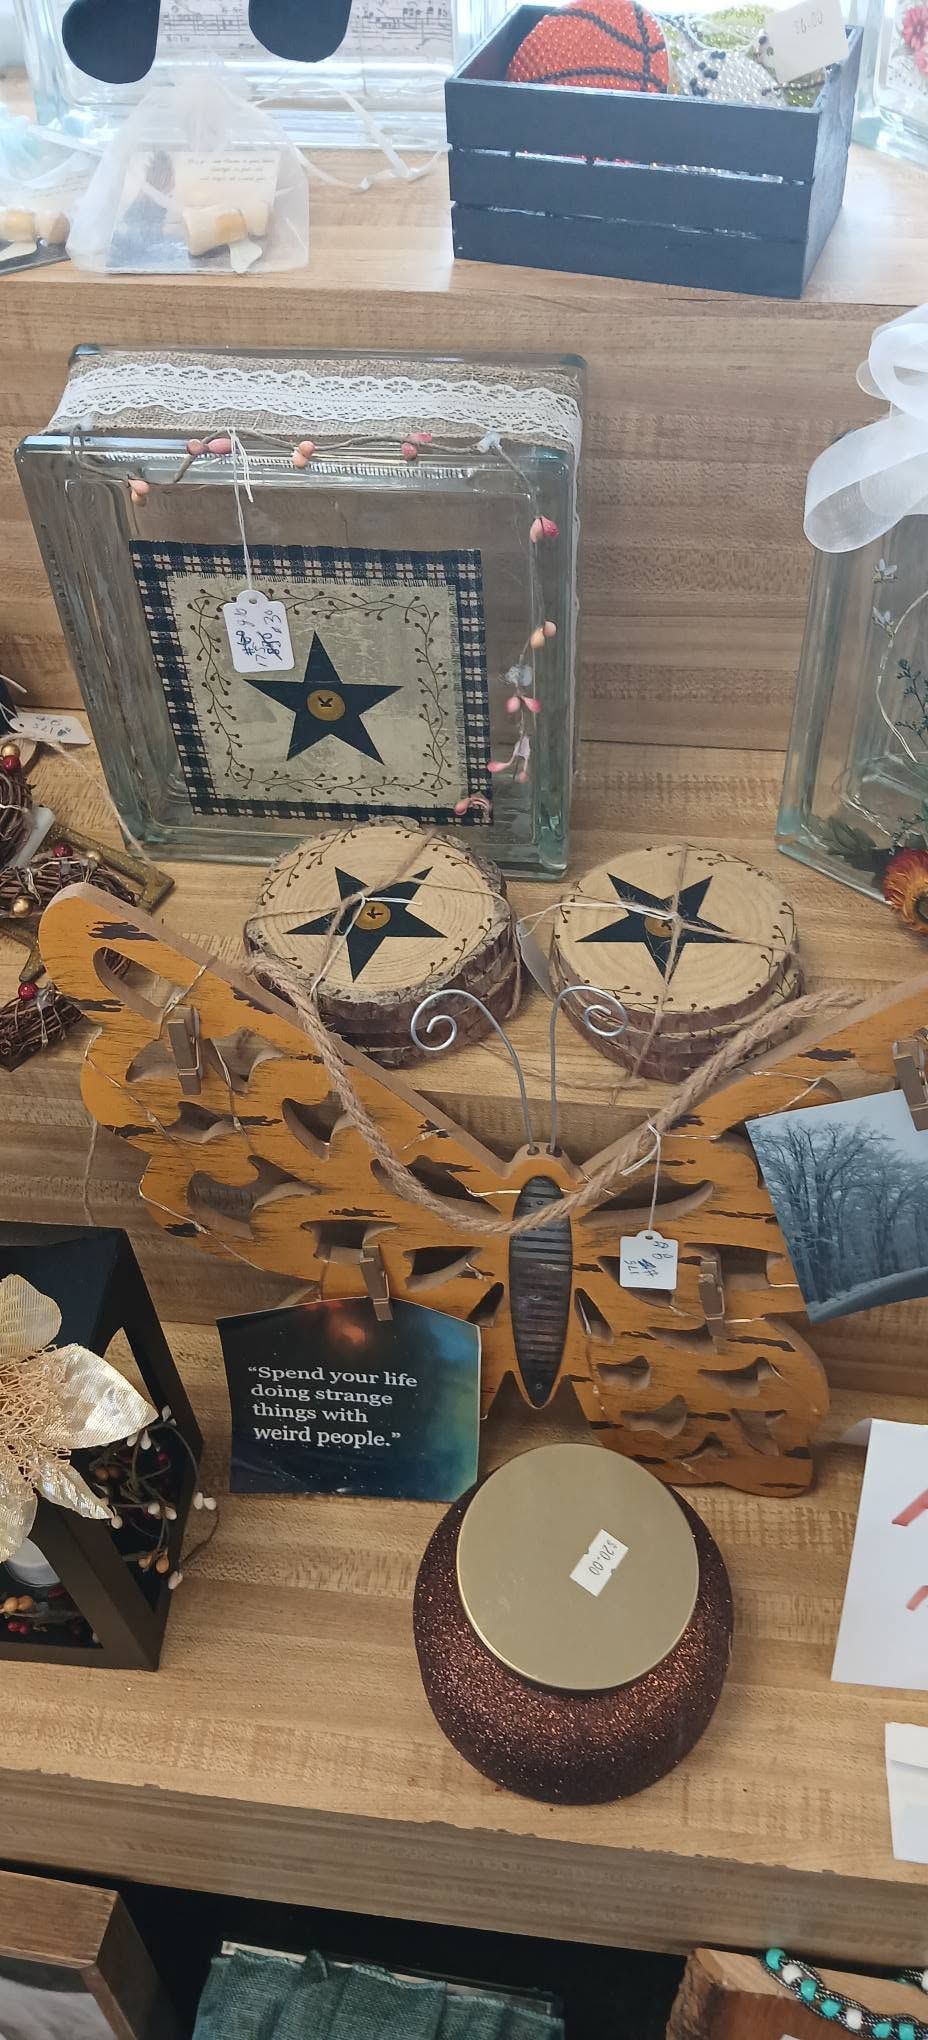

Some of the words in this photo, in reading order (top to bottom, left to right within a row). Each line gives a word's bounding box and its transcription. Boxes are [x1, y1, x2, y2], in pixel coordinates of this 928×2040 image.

[248, 1366, 325, 1381] “Spend
[329, 1371, 379, 1385] your
[384, 1371, 418, 1387] life
[251, 1384, 310, 1402] doing
[314, 1388, 393, 1406] strange
[252, 1403, 316, 1422] things
[322, 1407, 368, 1423] with
[253, 1426, 311, 1442] weird
[316, 1431, 401, 1448] people.”
